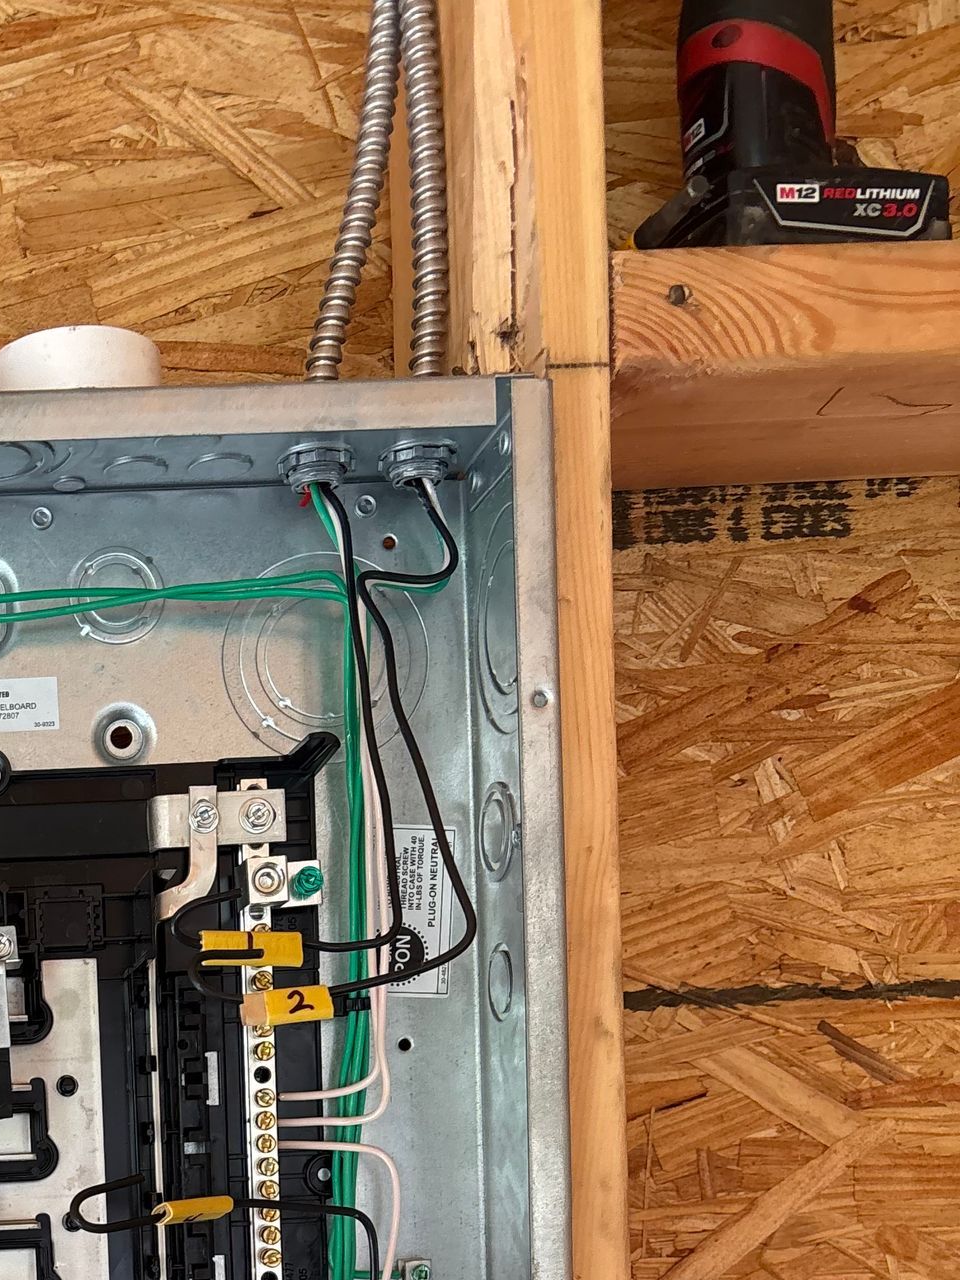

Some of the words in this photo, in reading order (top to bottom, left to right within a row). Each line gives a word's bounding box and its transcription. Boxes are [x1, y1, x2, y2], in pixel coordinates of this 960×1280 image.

[780, 187, 816, 199] M12
[823, 188, 921, 200] REDLITHIUM
[410, 835, 417, 844] 40
[401, 846, 409, 875] SCREW
[416, 871, 422, 882] OF
[427, 883, 437, 927] PLUG-ON
[287, 989, 314, 1014] 2
[298, 1268, 307, 1280] 05
